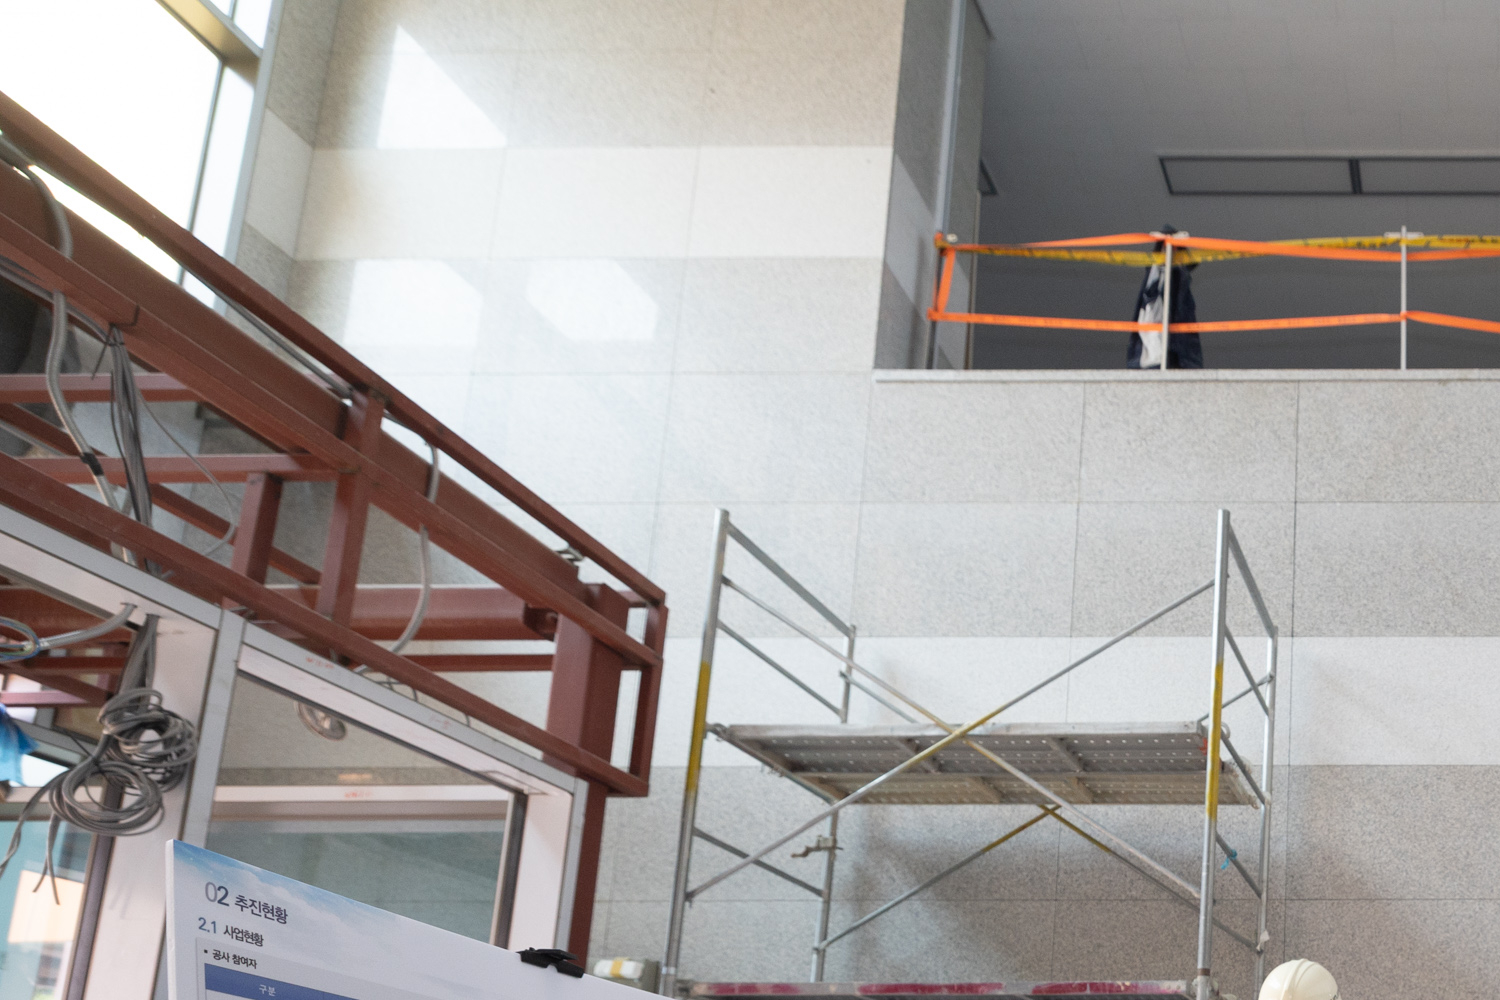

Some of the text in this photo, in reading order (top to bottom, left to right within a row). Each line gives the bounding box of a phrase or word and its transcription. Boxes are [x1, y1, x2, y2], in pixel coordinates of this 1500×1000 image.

[205, 882, 288, 924] 02 추진현황
[198, 917, 264, 948] 2.1 사업현황
[212, 949, 258, 970] 공사 참여자
[259, 984, 276, 997] 구분
